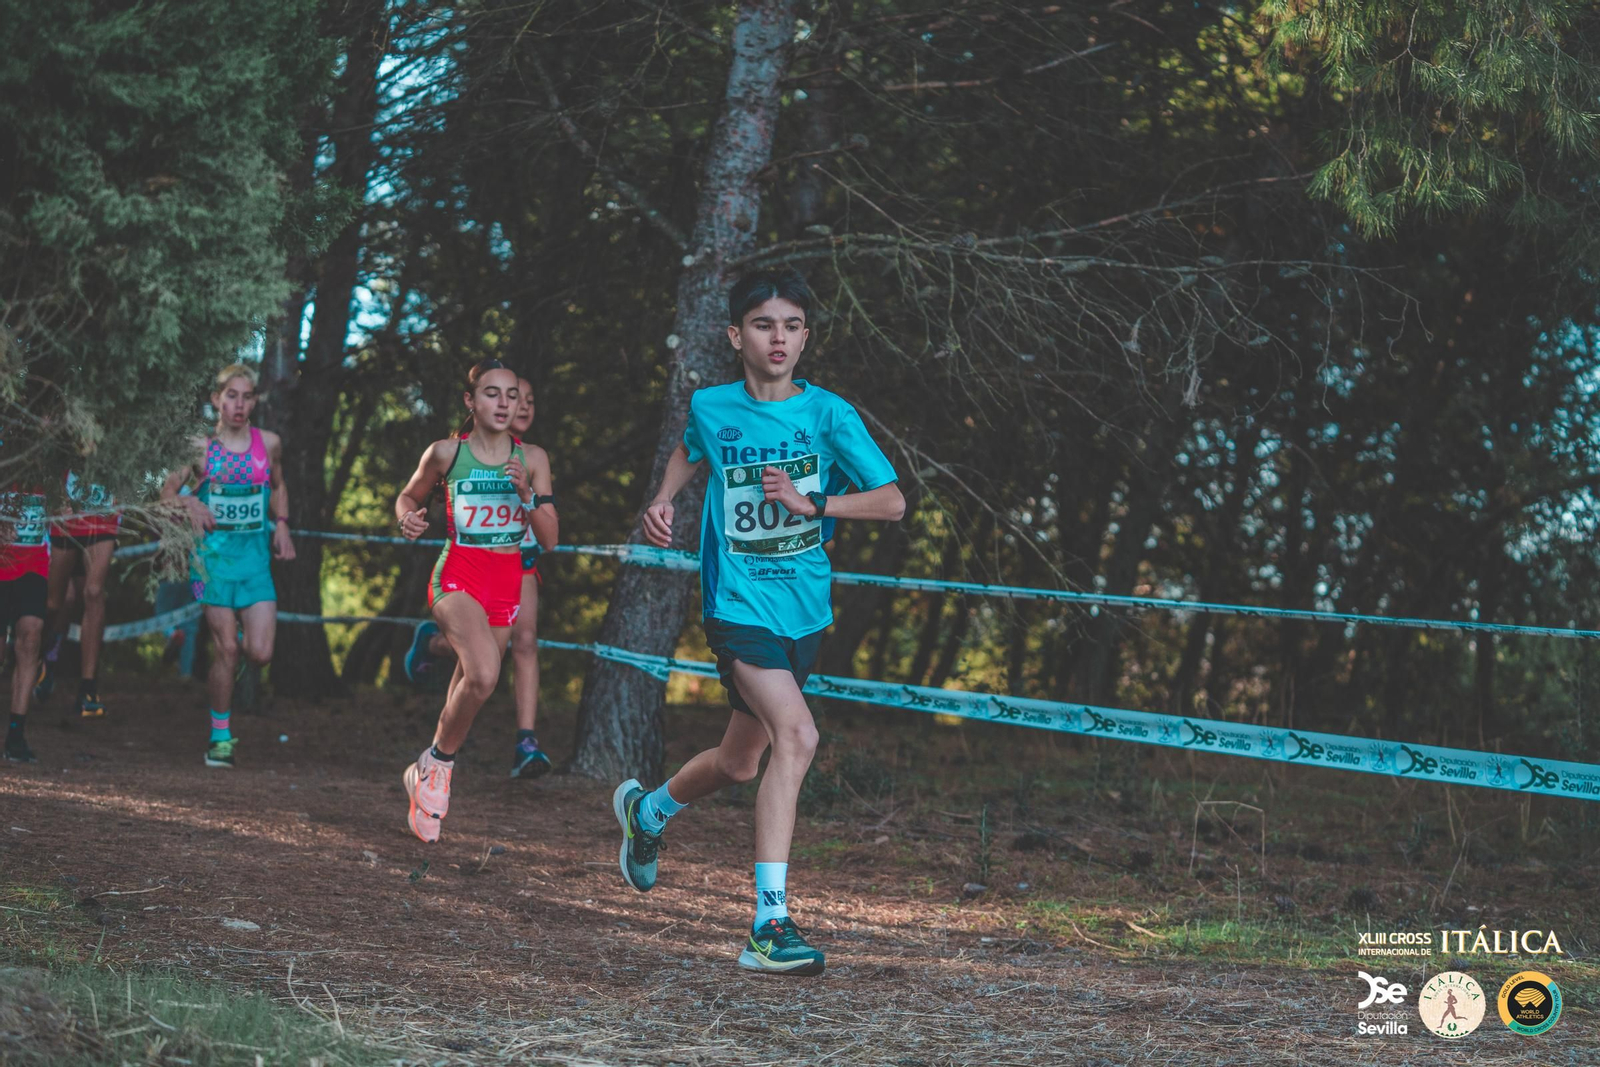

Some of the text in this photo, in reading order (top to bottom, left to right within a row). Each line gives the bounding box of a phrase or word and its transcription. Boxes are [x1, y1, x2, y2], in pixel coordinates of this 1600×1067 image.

[214, 502, 260, 520] 5896
[463, 504, 526, 528] 7294
[734, 501, 813, 532] 802
[1218, 738, 1251, 751] Sevilla
[1326, 751, 1361, 765] Sevilla
[1439, 765, 1477, 780] Sevilla
[1561, 780, 1600, 795] Sevilla
